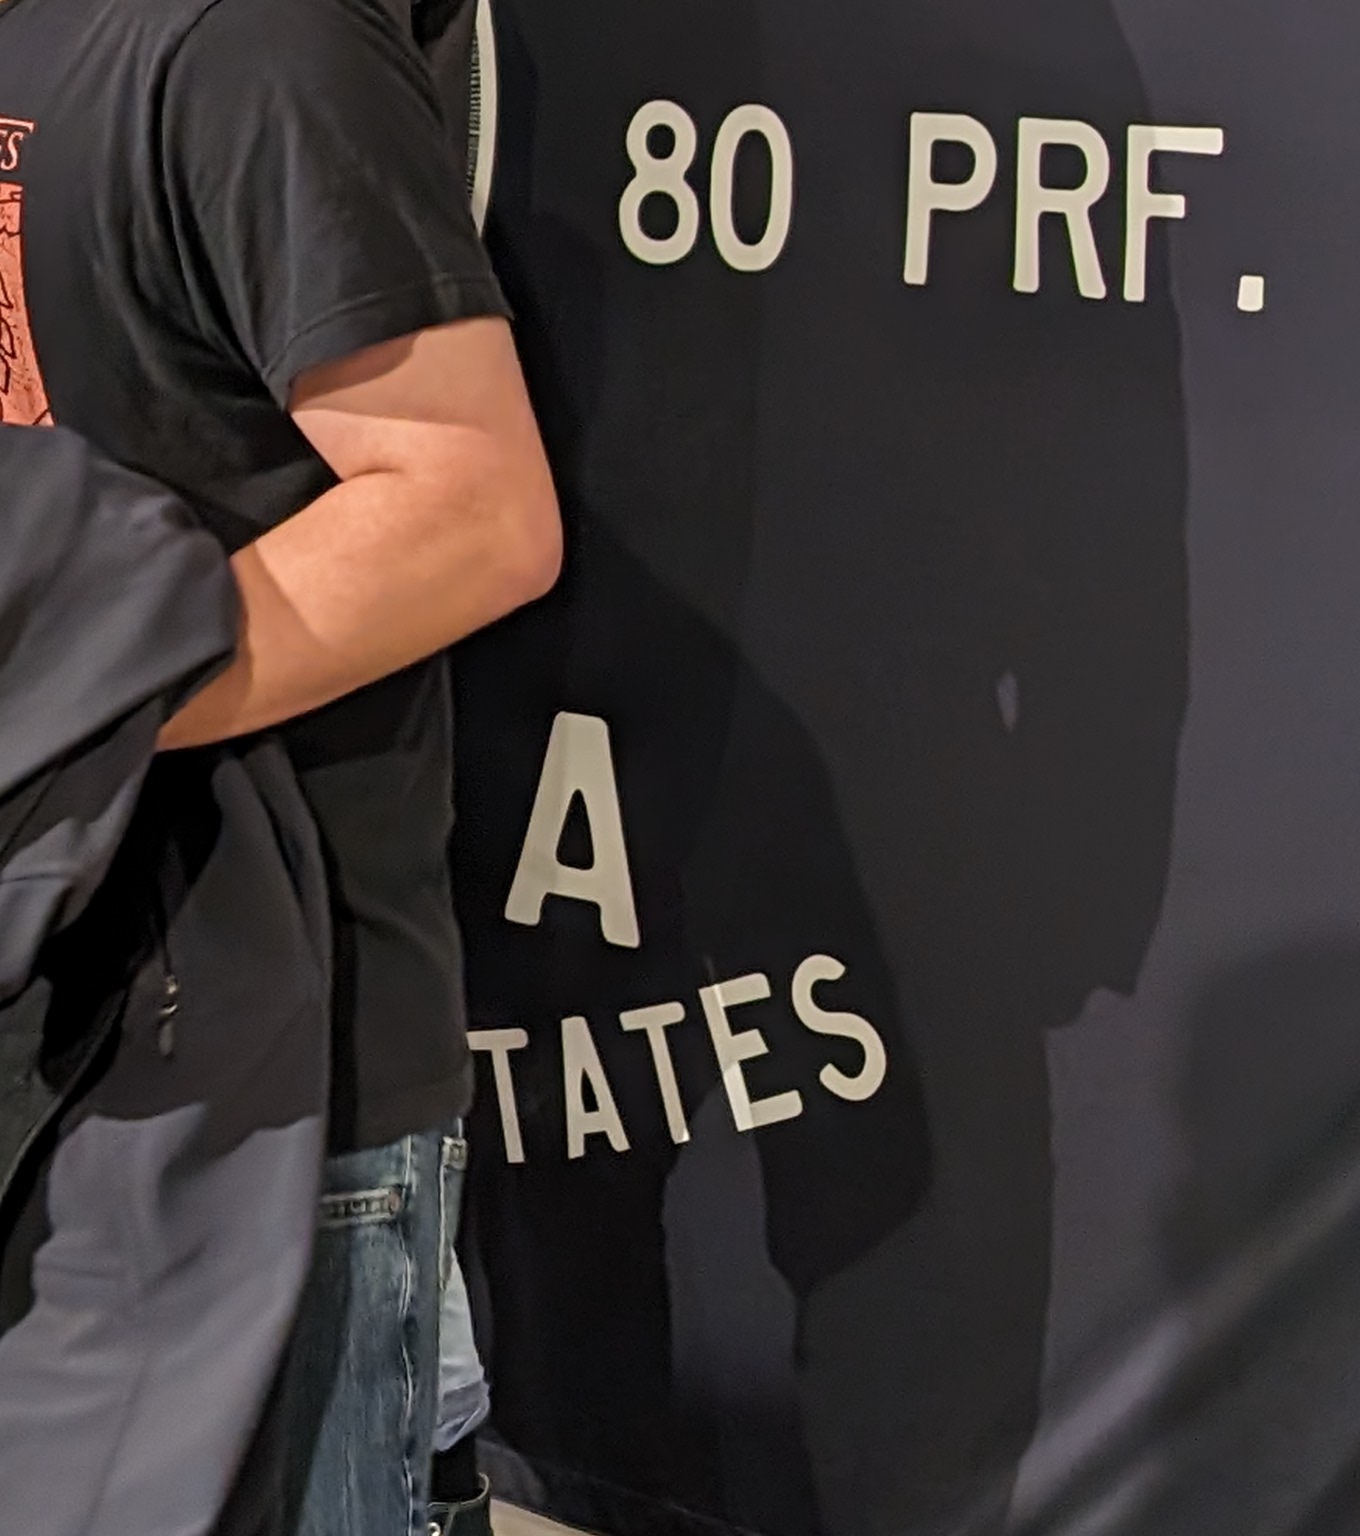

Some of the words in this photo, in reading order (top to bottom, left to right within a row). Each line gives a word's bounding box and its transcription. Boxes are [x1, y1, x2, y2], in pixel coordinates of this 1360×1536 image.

[618, 98, 794, 273] 80
[903, 110, 1266, 312] PRF.
[466, 952, 888, 1164] TATES
